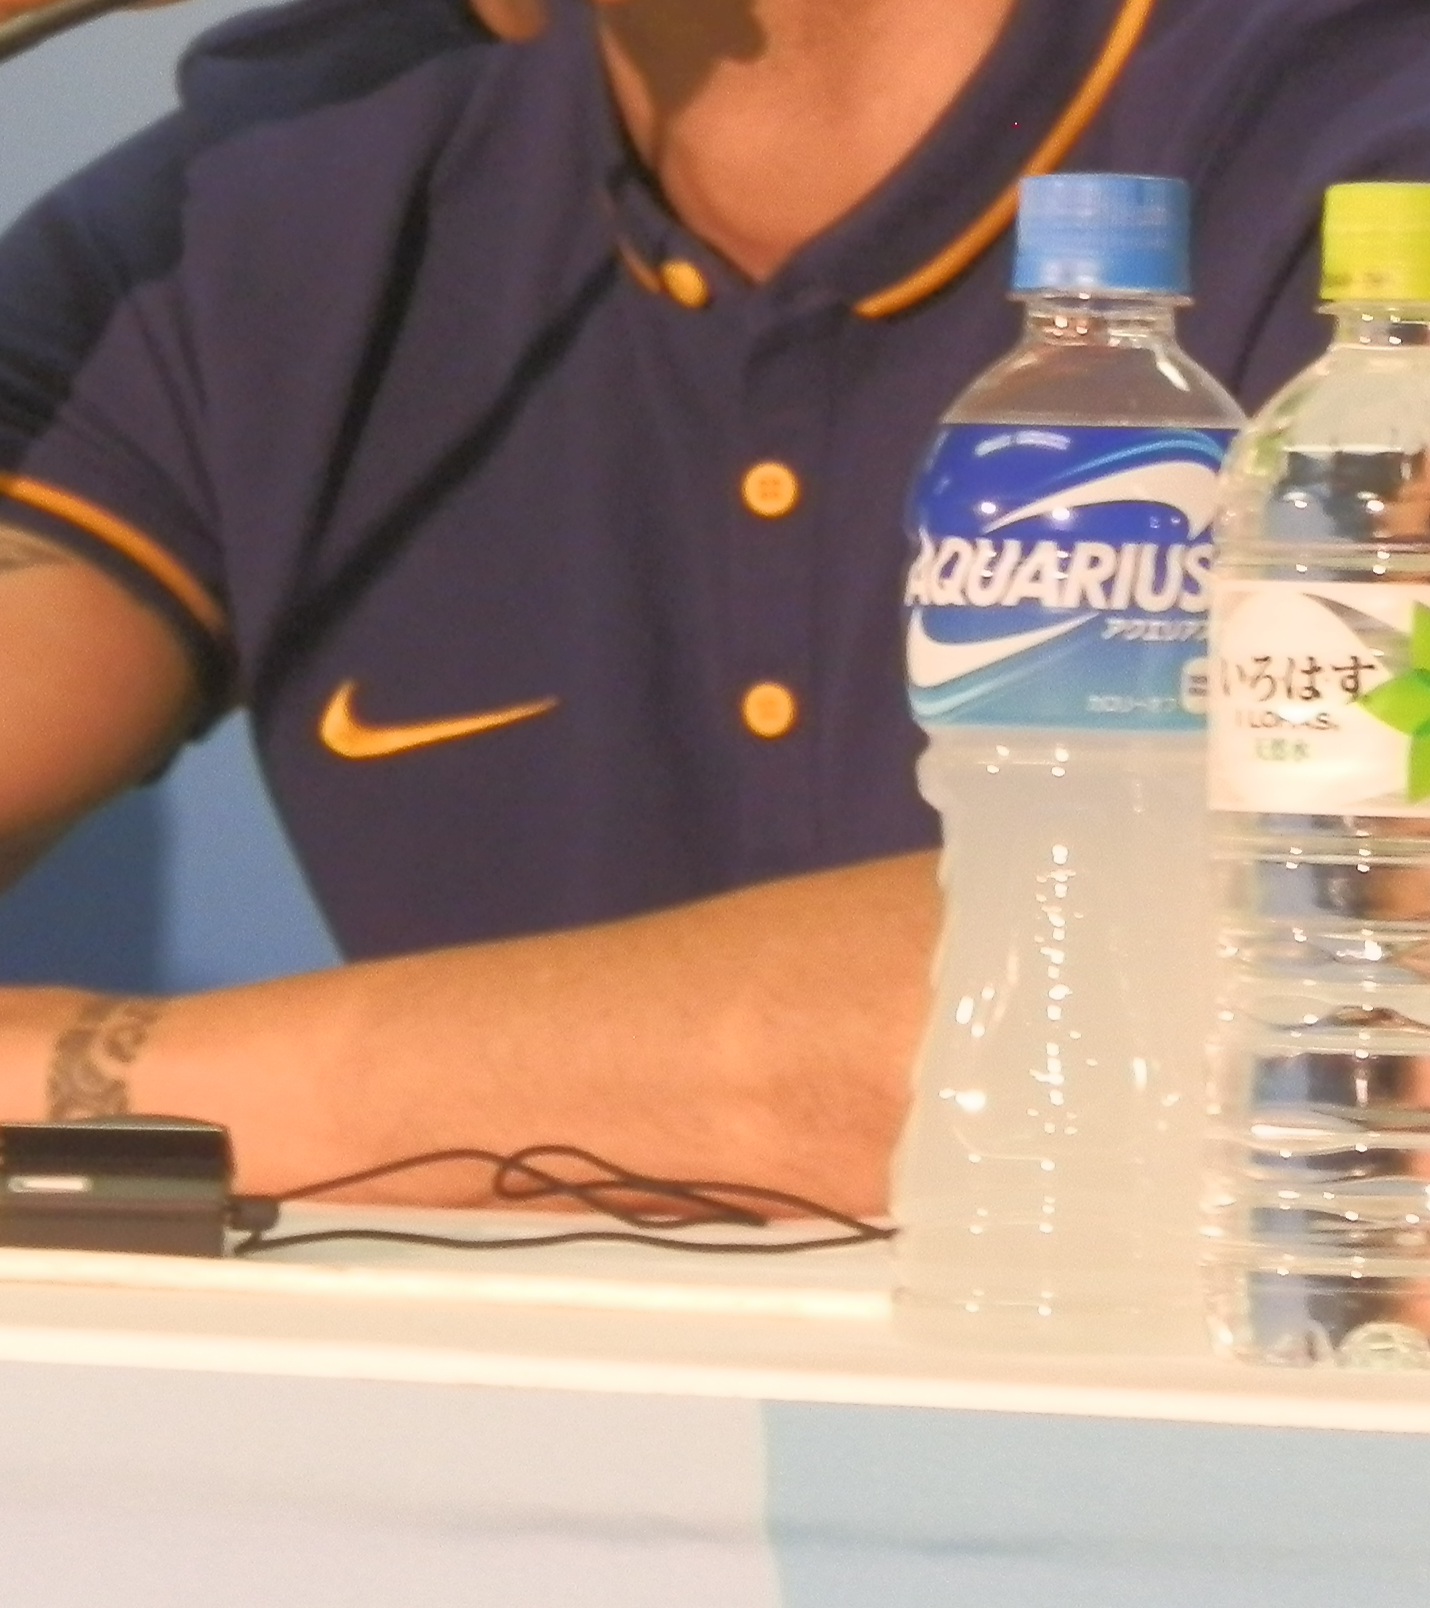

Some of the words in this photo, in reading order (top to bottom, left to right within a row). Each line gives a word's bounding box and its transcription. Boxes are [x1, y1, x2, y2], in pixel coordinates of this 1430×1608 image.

[903, 535, 1215, 615] AQUARIUS
[1220, 654, 1377, 705] いろはす
